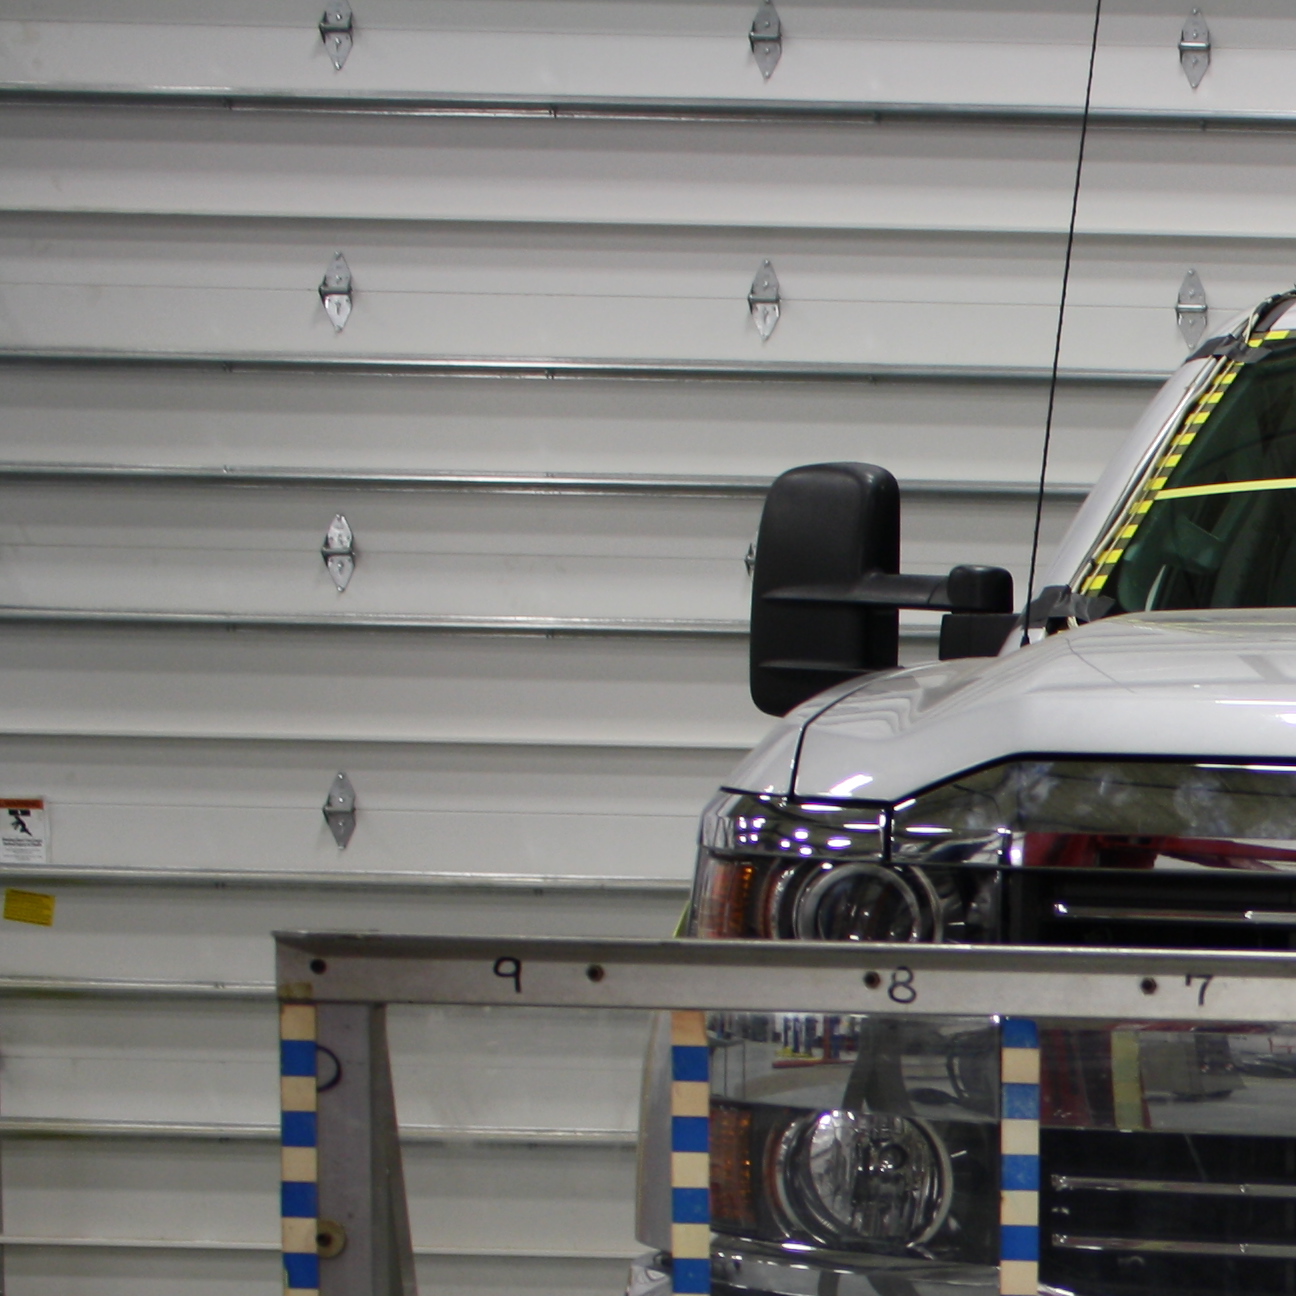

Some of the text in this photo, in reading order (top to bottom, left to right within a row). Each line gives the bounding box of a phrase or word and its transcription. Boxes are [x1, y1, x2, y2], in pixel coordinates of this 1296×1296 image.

[493, 957, 523, 994] 9
[887, 966, 918, 1004] 8
[1184, 973, 1215, 1007] 7
